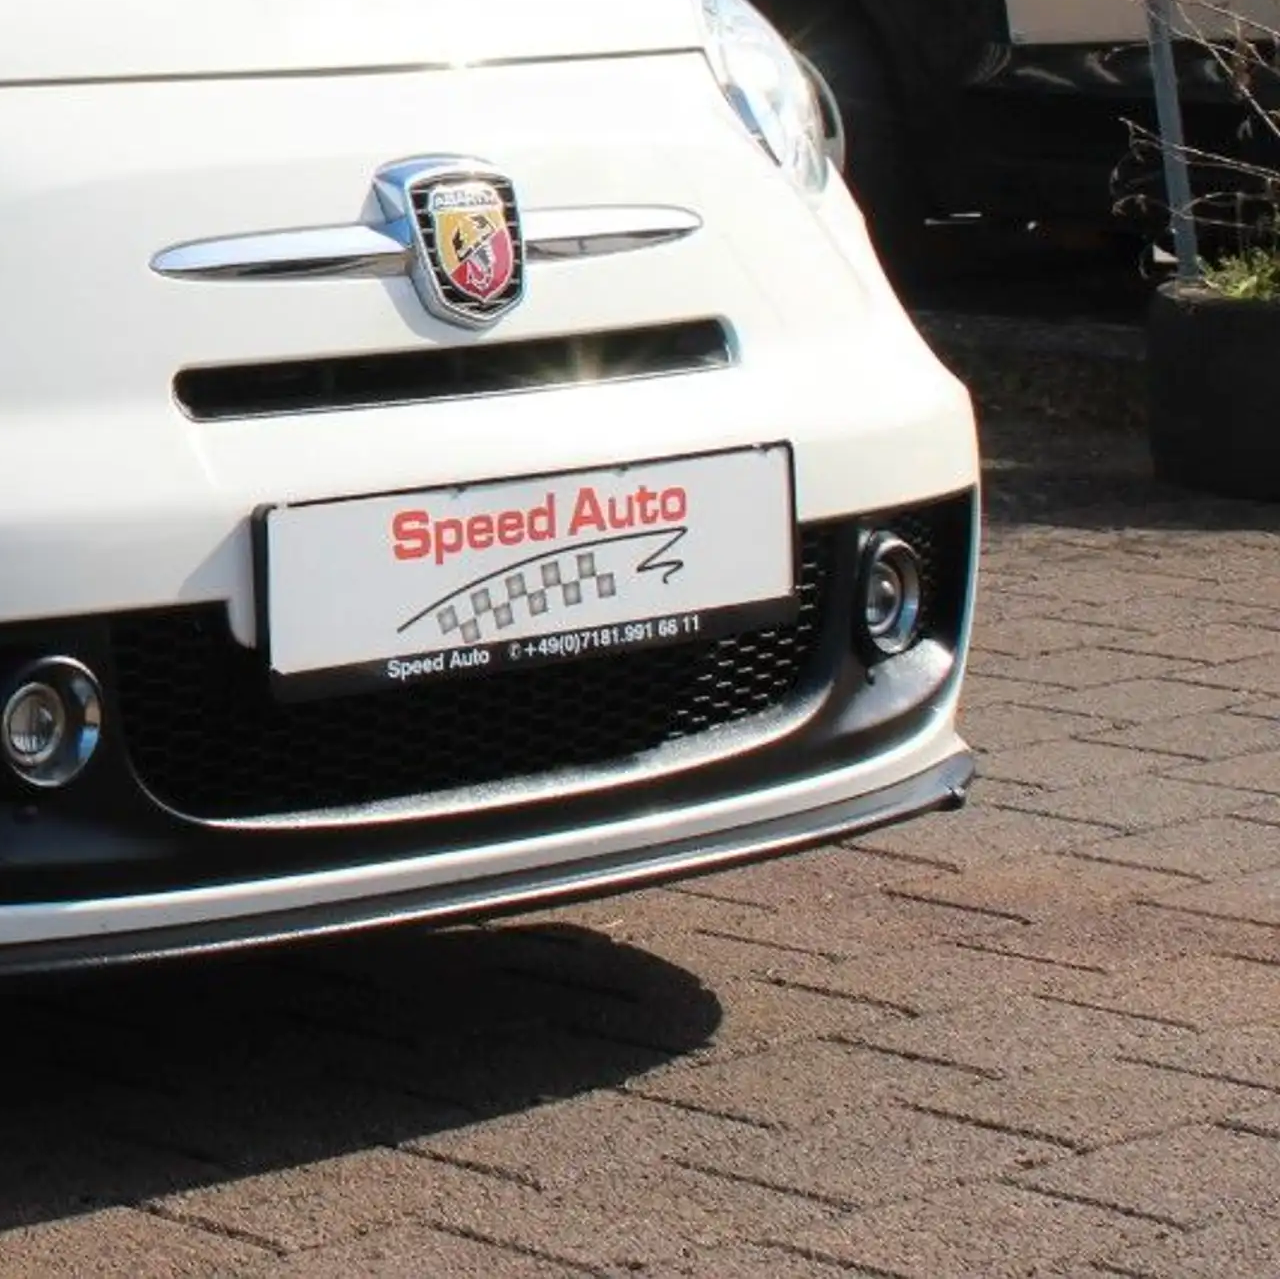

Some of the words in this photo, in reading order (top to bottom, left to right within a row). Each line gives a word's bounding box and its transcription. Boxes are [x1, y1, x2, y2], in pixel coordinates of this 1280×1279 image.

[392, 492, 556, 565] Speed
[567, 484, 687, 536] Auto
[387, 652, 445, 681] Speed
[449, 647, 490, 669] Auto
[683, 614, 699, 632] 11
